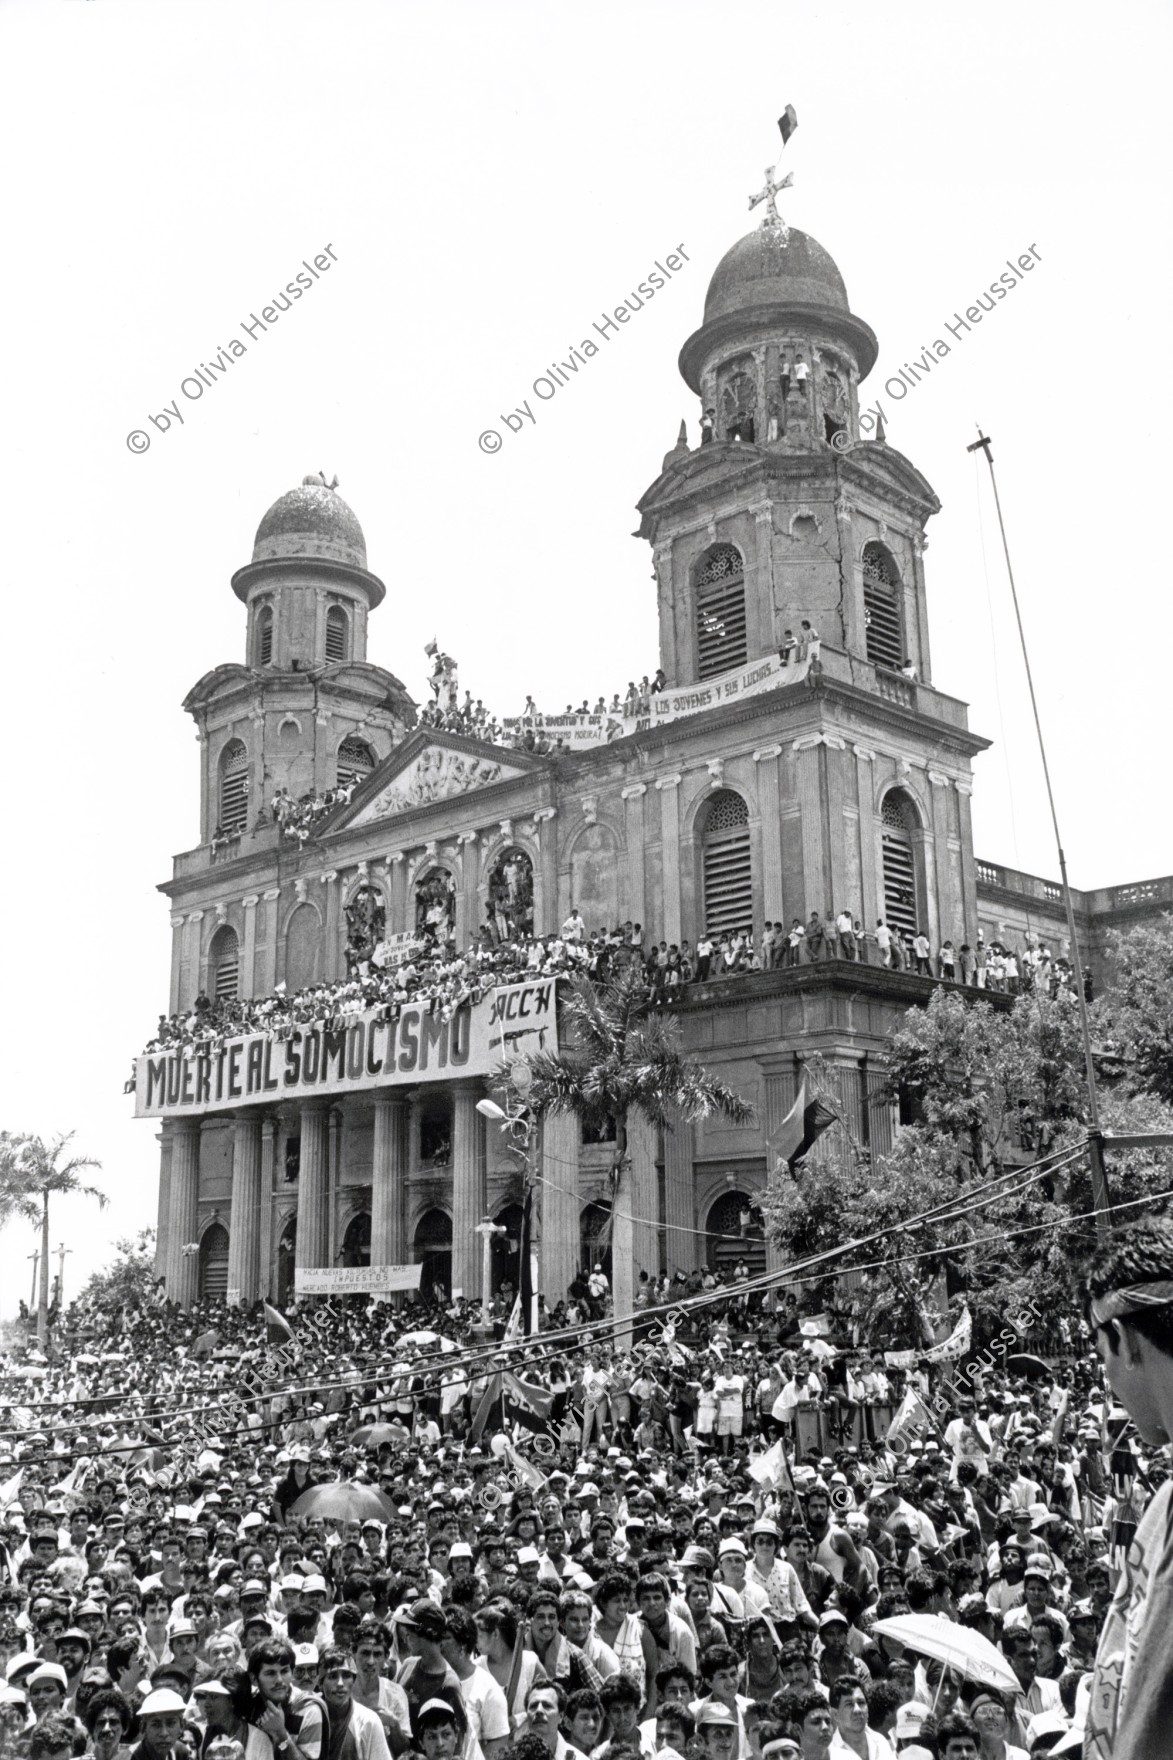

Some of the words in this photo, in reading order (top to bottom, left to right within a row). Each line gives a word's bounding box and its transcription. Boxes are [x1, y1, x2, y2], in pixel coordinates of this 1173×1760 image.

[715, 686, 721, 700] Y
[725, 681, 738, 697] SUS
[535, 717, 544, 727] LA
[580, 716, 585, 726] Y
[588, 715, 602, 725] SUS
[145, 1041, 244, 1109] MUERTE
[246, 1039, 278, 1096] AL
[283, 1005, 472, 1088] SOMOCISMO
[334, 1274, 389, 1283] IMPUESTOS
